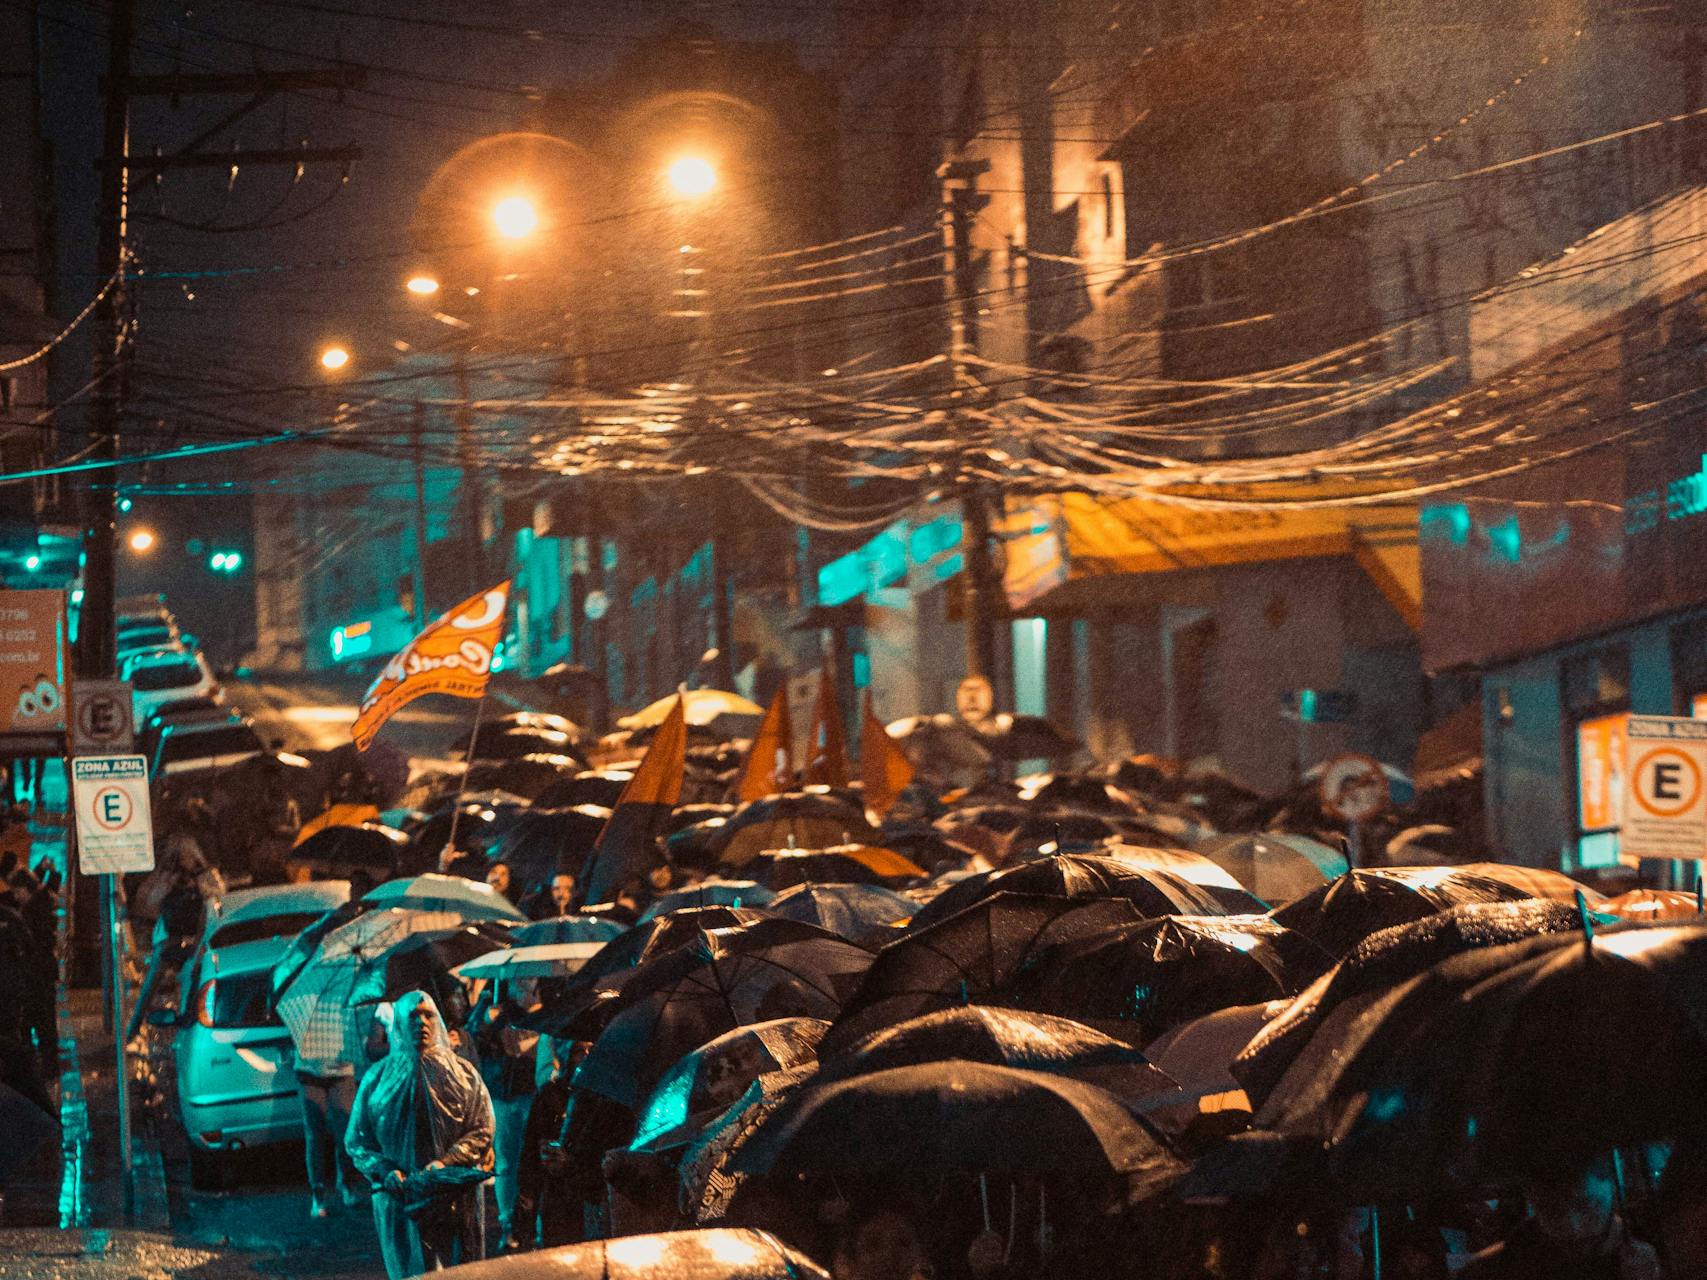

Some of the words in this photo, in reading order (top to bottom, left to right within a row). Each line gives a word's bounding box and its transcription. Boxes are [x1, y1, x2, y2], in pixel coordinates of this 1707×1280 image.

[91, 702, 113, 734] E
[77, 762, 111, 773] ZONA
[112, 760, 144, 771] AZUL
[1654, 763, 1681, 800] E
[103, 795, 122, 822] E
